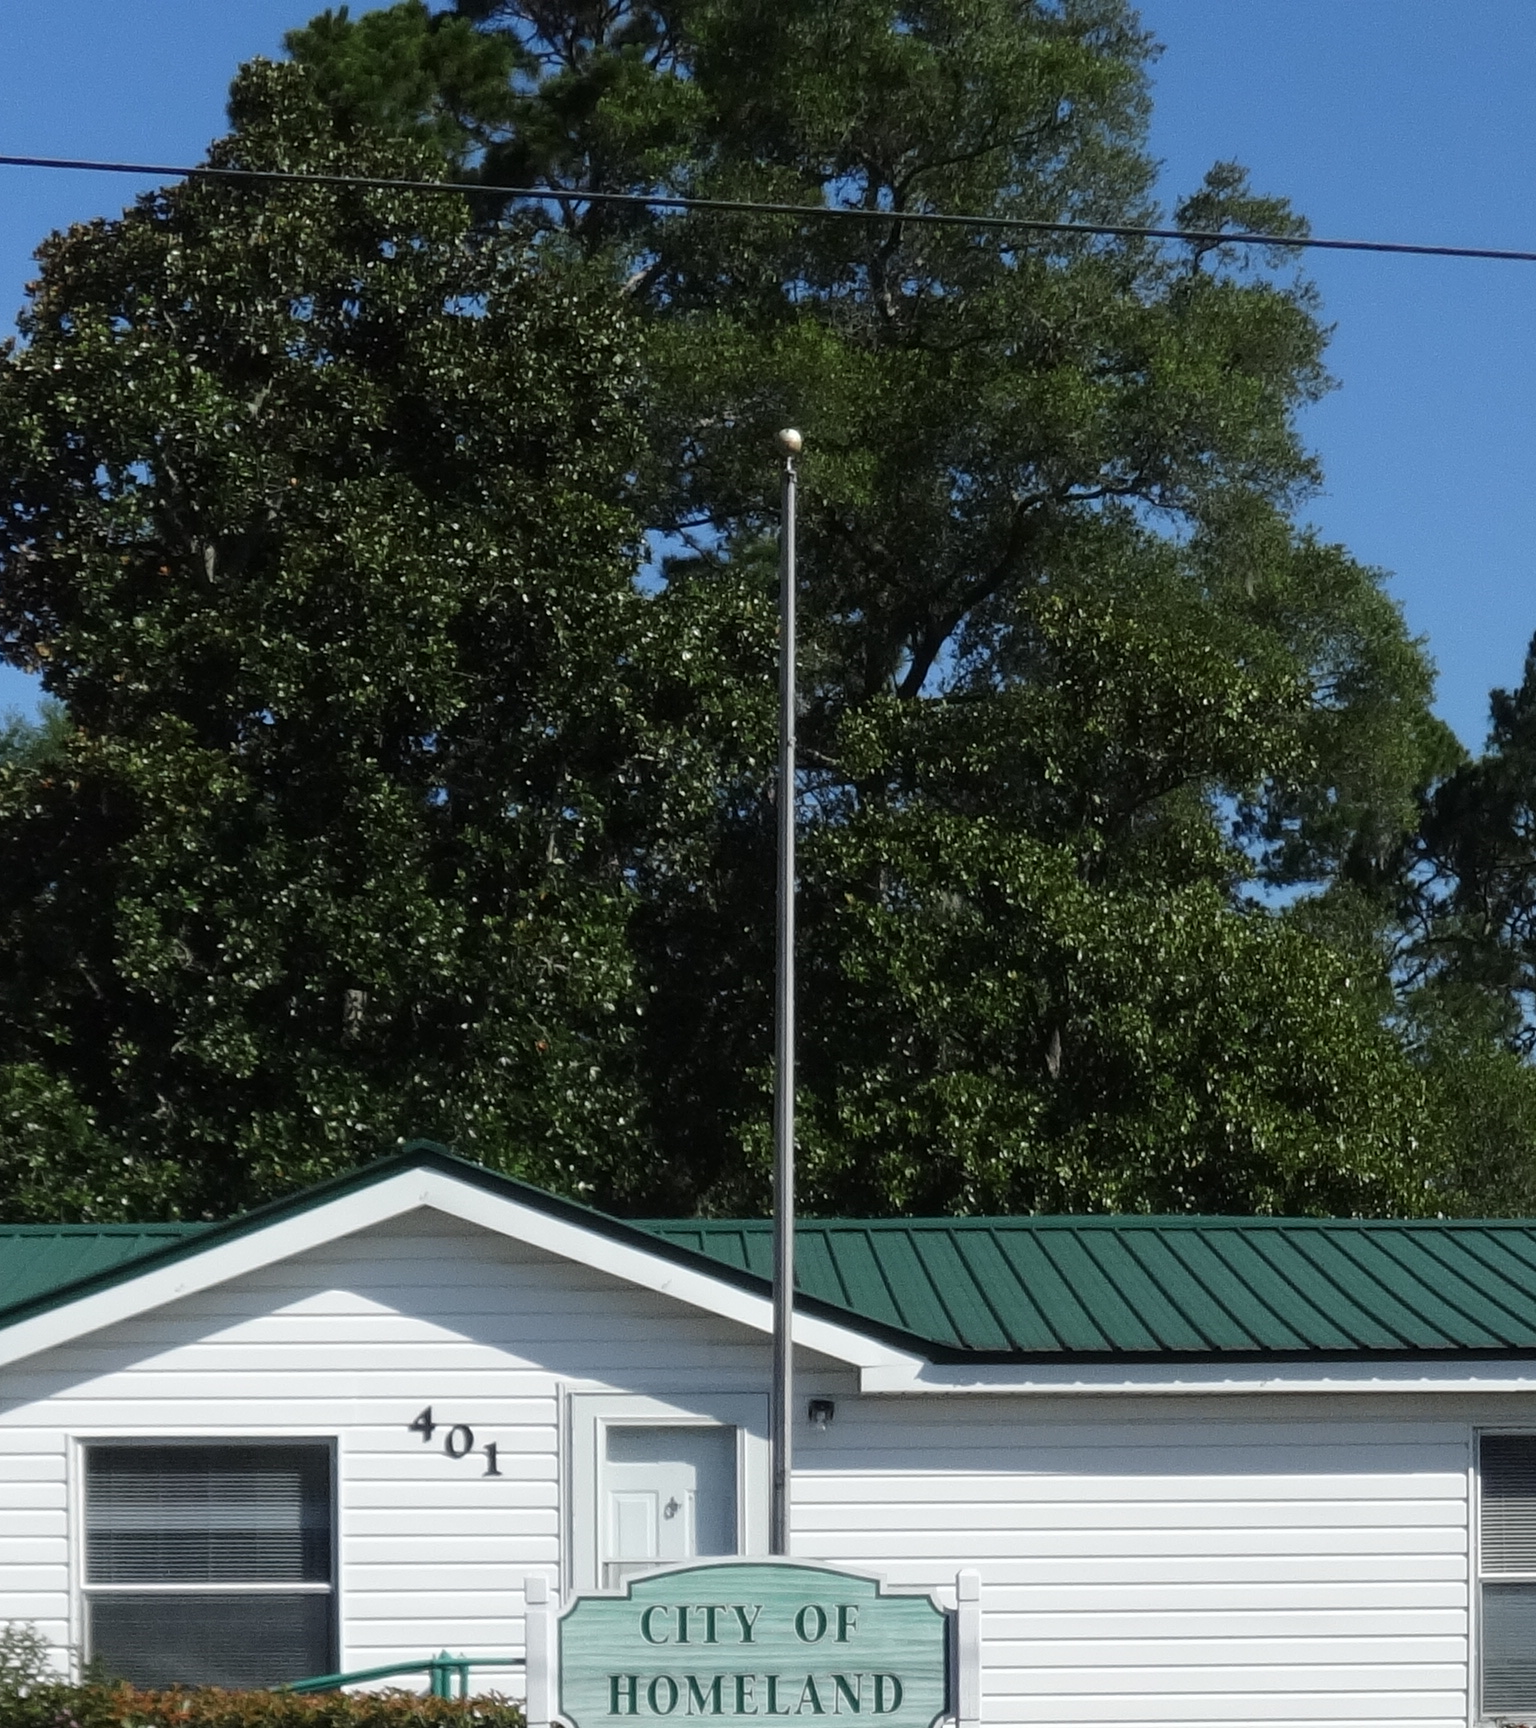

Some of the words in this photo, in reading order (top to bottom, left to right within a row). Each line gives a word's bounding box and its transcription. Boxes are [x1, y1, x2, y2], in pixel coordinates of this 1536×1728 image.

[408, 1405, 503, 1477] 401
[640, 1604, 763, 1646] CITY
[794, 1603, 860, 1645] OF
[606, 1673, 904, 1717] HOMELAND
